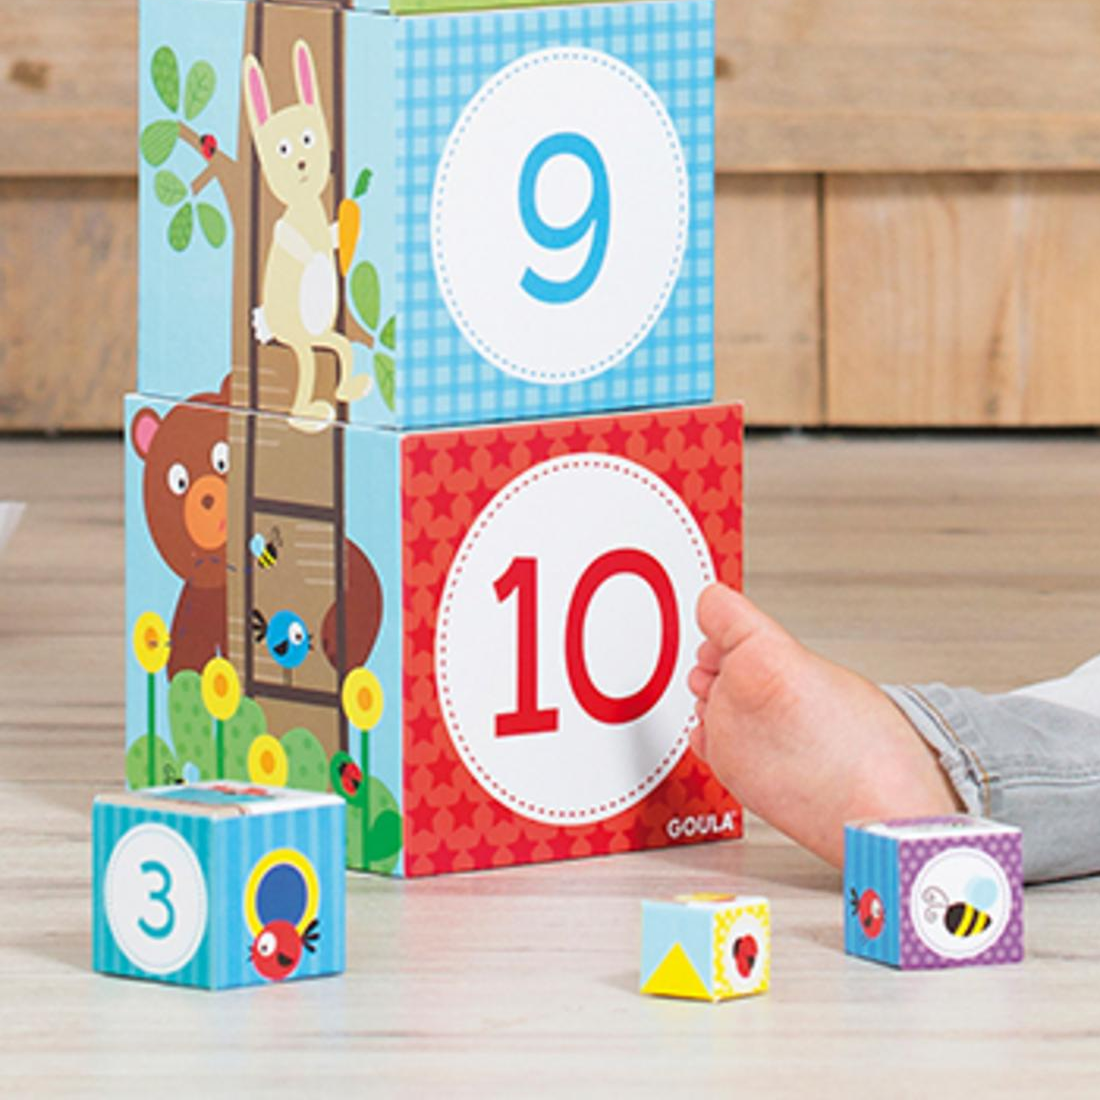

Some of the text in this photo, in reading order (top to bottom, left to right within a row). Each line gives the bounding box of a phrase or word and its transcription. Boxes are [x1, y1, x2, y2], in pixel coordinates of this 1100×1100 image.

[517, 131, 612, 305] 9
[491, 547, 681, 739] 10
[666, 811, 736, 840] GOULA
[138, 860, 175, 939] 3
